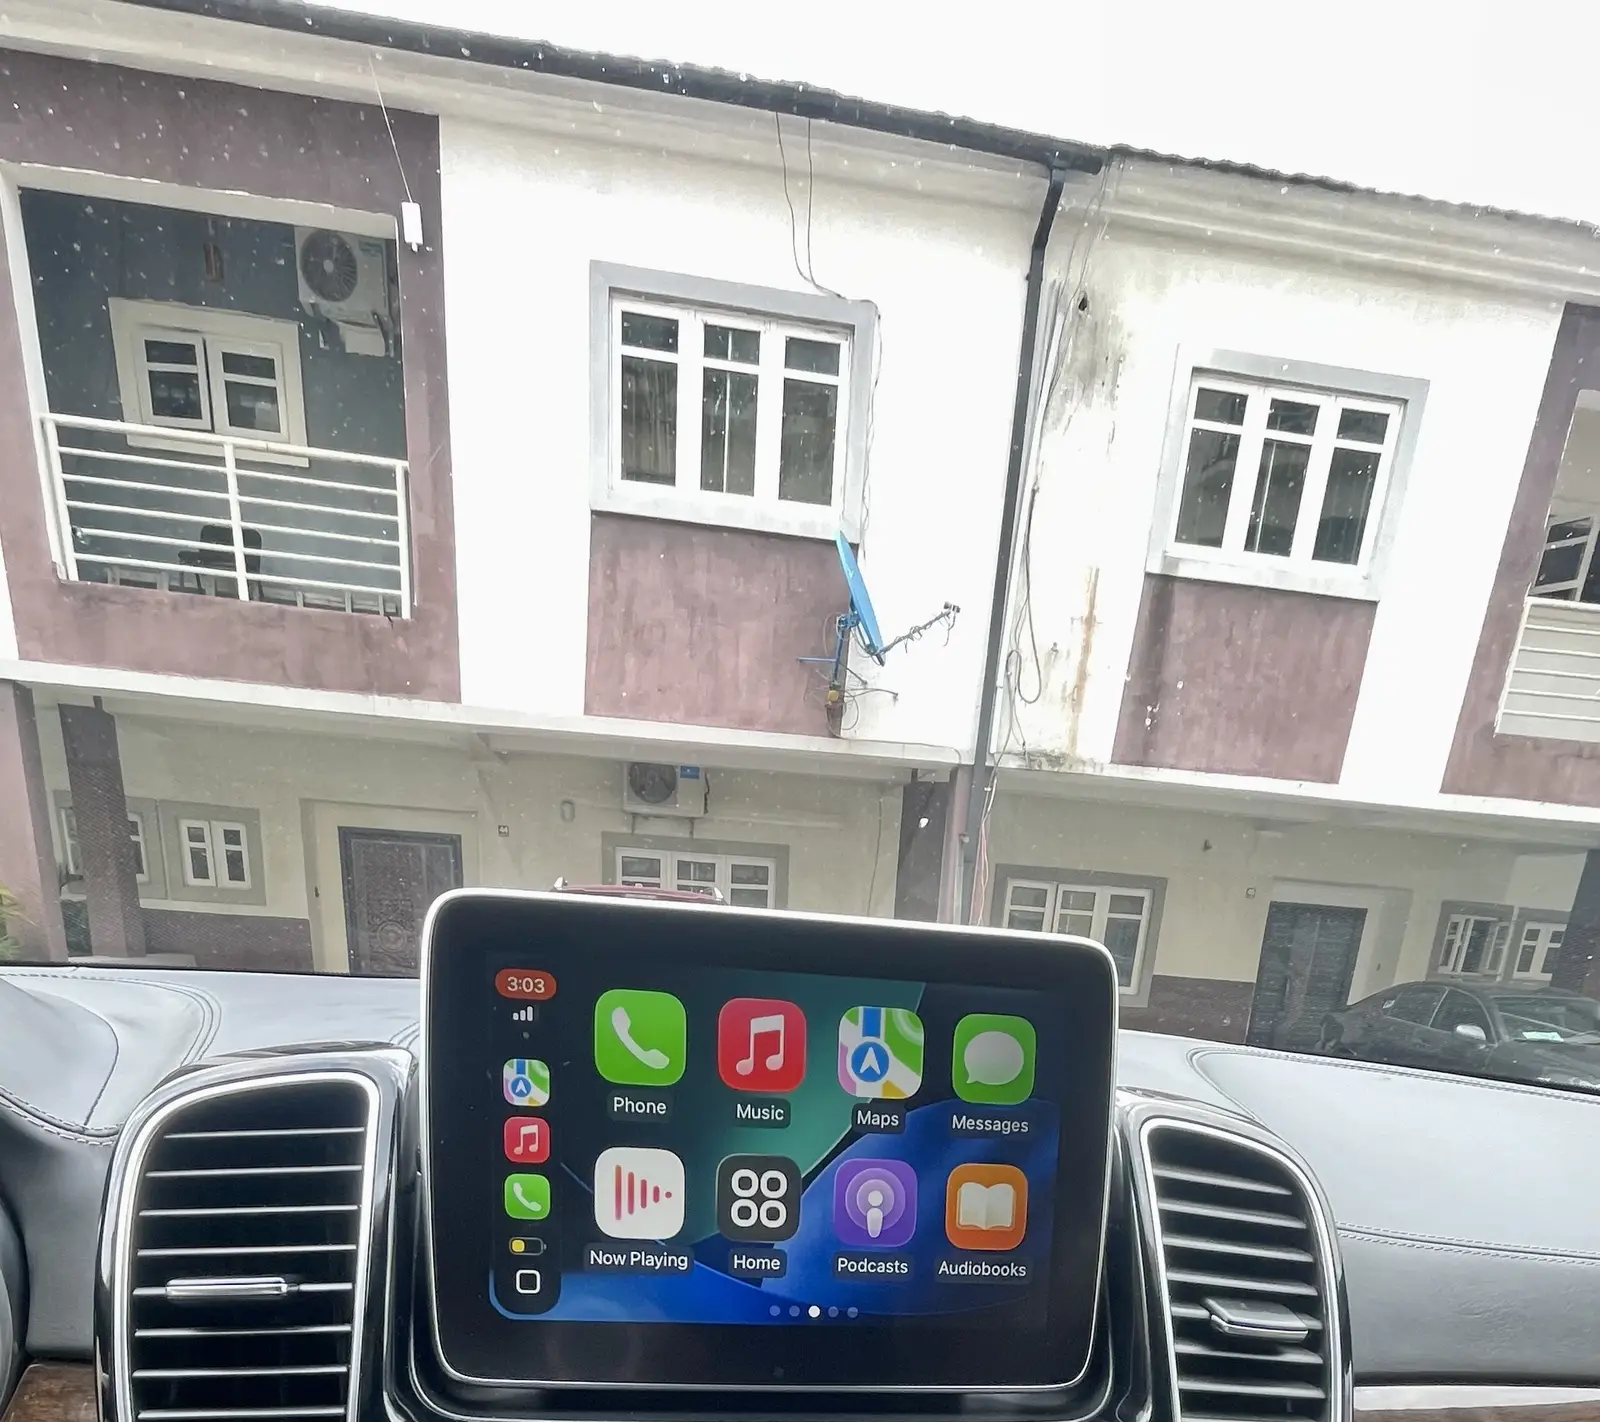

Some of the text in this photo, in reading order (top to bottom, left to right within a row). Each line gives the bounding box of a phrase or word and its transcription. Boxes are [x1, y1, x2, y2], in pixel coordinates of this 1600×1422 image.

[507, 976, 545, 994] 3:03
[613, 1097, 667, 1115] Phone
[736, 1103, 785, 1122] Music
[857, 1109, 900, 1129] Maps
[952, 1115, 1030, 1135] Messages
[590, 1250, 689, 1272] Now Playing
[733, 1254, 781, 1271] Home
[837, 1257, 909, 1275] Podcasts
[938, 1259, 1027, 1278] Audiobooks
